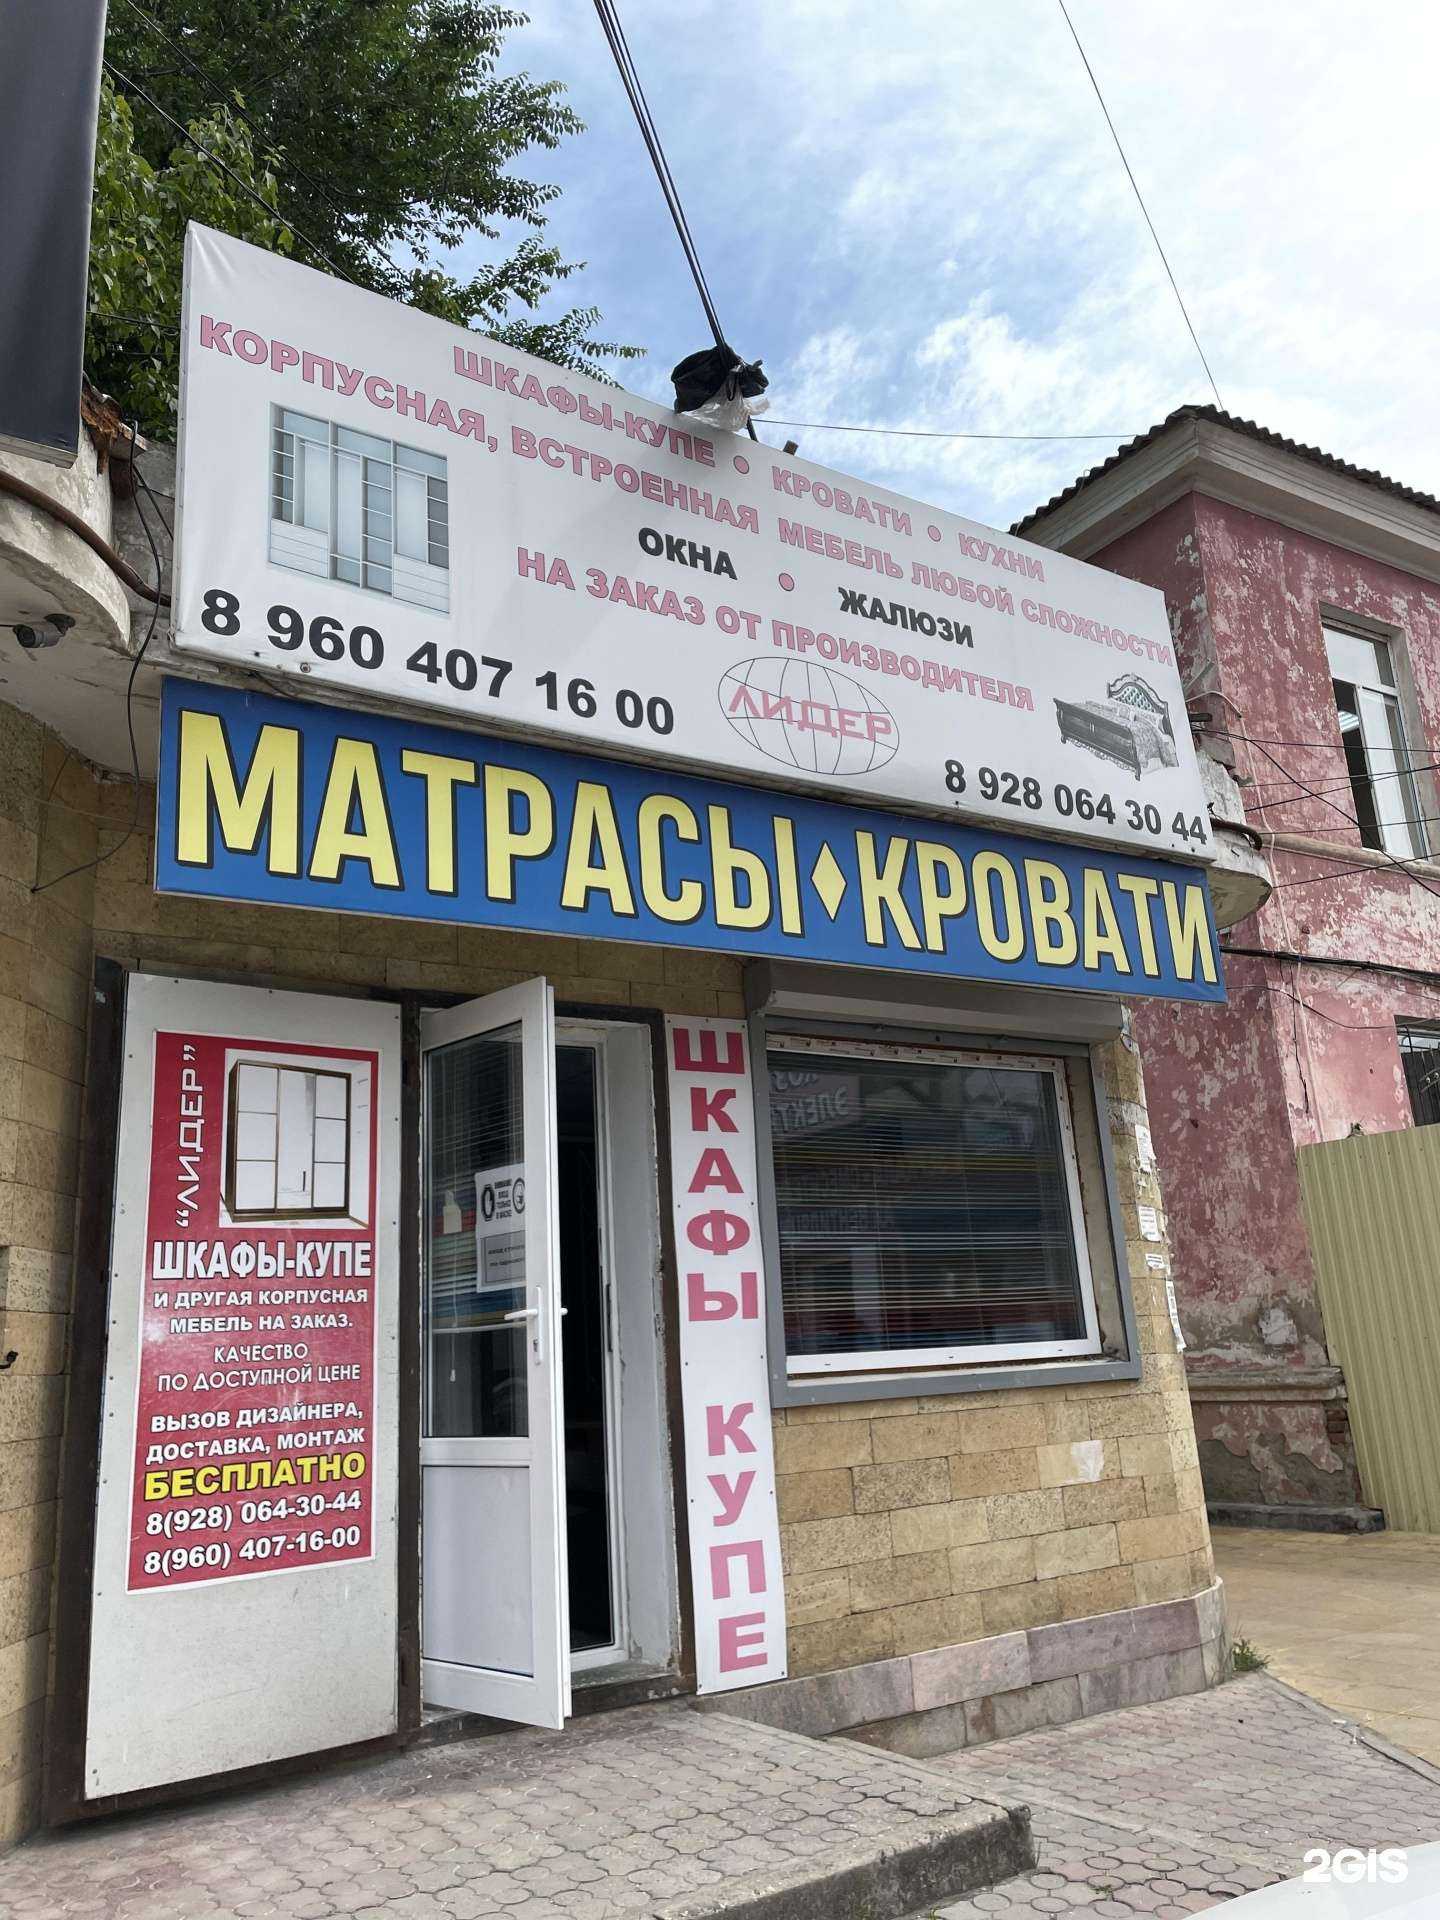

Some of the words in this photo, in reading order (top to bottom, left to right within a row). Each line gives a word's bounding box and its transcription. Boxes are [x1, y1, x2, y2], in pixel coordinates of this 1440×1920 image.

[200, 314, 499, 453] КОРПУСНАЯ,
[512, 425, 759, 535] ВСТРОЕННАЯ
[778, 518, 904, 578] МЕБЕЛЬ
[911, 561, 1015, 616] ЛЮБОЙ
[1021, 599, 1174, 666] СЛОЖНОСТИ
[454, 346, 715, 467] ШКАФЫ-КУПЕ
[772, 466, 912, 536] КРОВАТИ
[958, 532, 1045, 582] КУХНИ
[638, 527, 738, 580] ОКНА
[838, 586, 974, 648] ЖАЛЮЗИ
[517, 546, 576, 590] НА
[586, 567, 706, 625] ЗАКАЗ
[716, 606, 762, 640] ОТ
[772, 620, 1034, 712] ПРОИЗВОДИТЕЛЯ
[201, 589, 241, 636] 8
[267, 604, 385, 670] 960
[406, 641, 513, 699] 407
[535, 671, 597, 718] 16
[616, 689, 675, 735] 00
[728, 686, 892, 744] ЛИДЕР
[944, 760, 966, 794] 8
[978, 767, 1043, 810] 928
[1054, 783, 1116, 825] 064
[1125, 800, 1162, 835] 30
[1172, 811, 1208, 845] 44
[175, 708, 804, 937] МАТРАСЫ
[855, 829, 1220, 984] КРОВАТИ
[672, 1028, 759, 1321] ШКАФЫ
[151, 1241, 371, 1280] ШКАФЫ-КУПЕ
[153, 1292, 168, 1308] И
[174, 1291, 252, 1309] ДРУГАЯ
[258, 1289, 368, 1305] КОРПУСНАЯ
[170, 1316, 252, 1334] МЕБЕЛЬ
[258, 1315, 285, 1331] НА
[291, 1313, 353, 1329] ЗАКАЗ.
[158, 1374, 188, 1391] ПО
[193, 1364, 312, 1391] ДОСТУПНОЙ
[318, 1364, 361, 1383] ЦЕНЕ
[214, 1343, 308, 1363] КАЧЕСТВО
[151, 1411, 230, 1433] ВЫЗОВ
[236, 1402, 363, 1428] ДИЗАЙНЕРА,
[146, 1436, 270, 1465] ДОСТАВКА,
[277, 1427, 365, 1450] МОНТАЖ
[144, 1451, 366, 1501] БЕСПЛАТНО
[146, 1505, 232, 1538] 8(928)
[241, 1490, 361, 1523] 064-30-44
[705, 1402, 768, 1673] КУПЕ
[144, 1542, 231, 1576] 8(960)
[239, 1525, 360, 1560] 407-16-00
